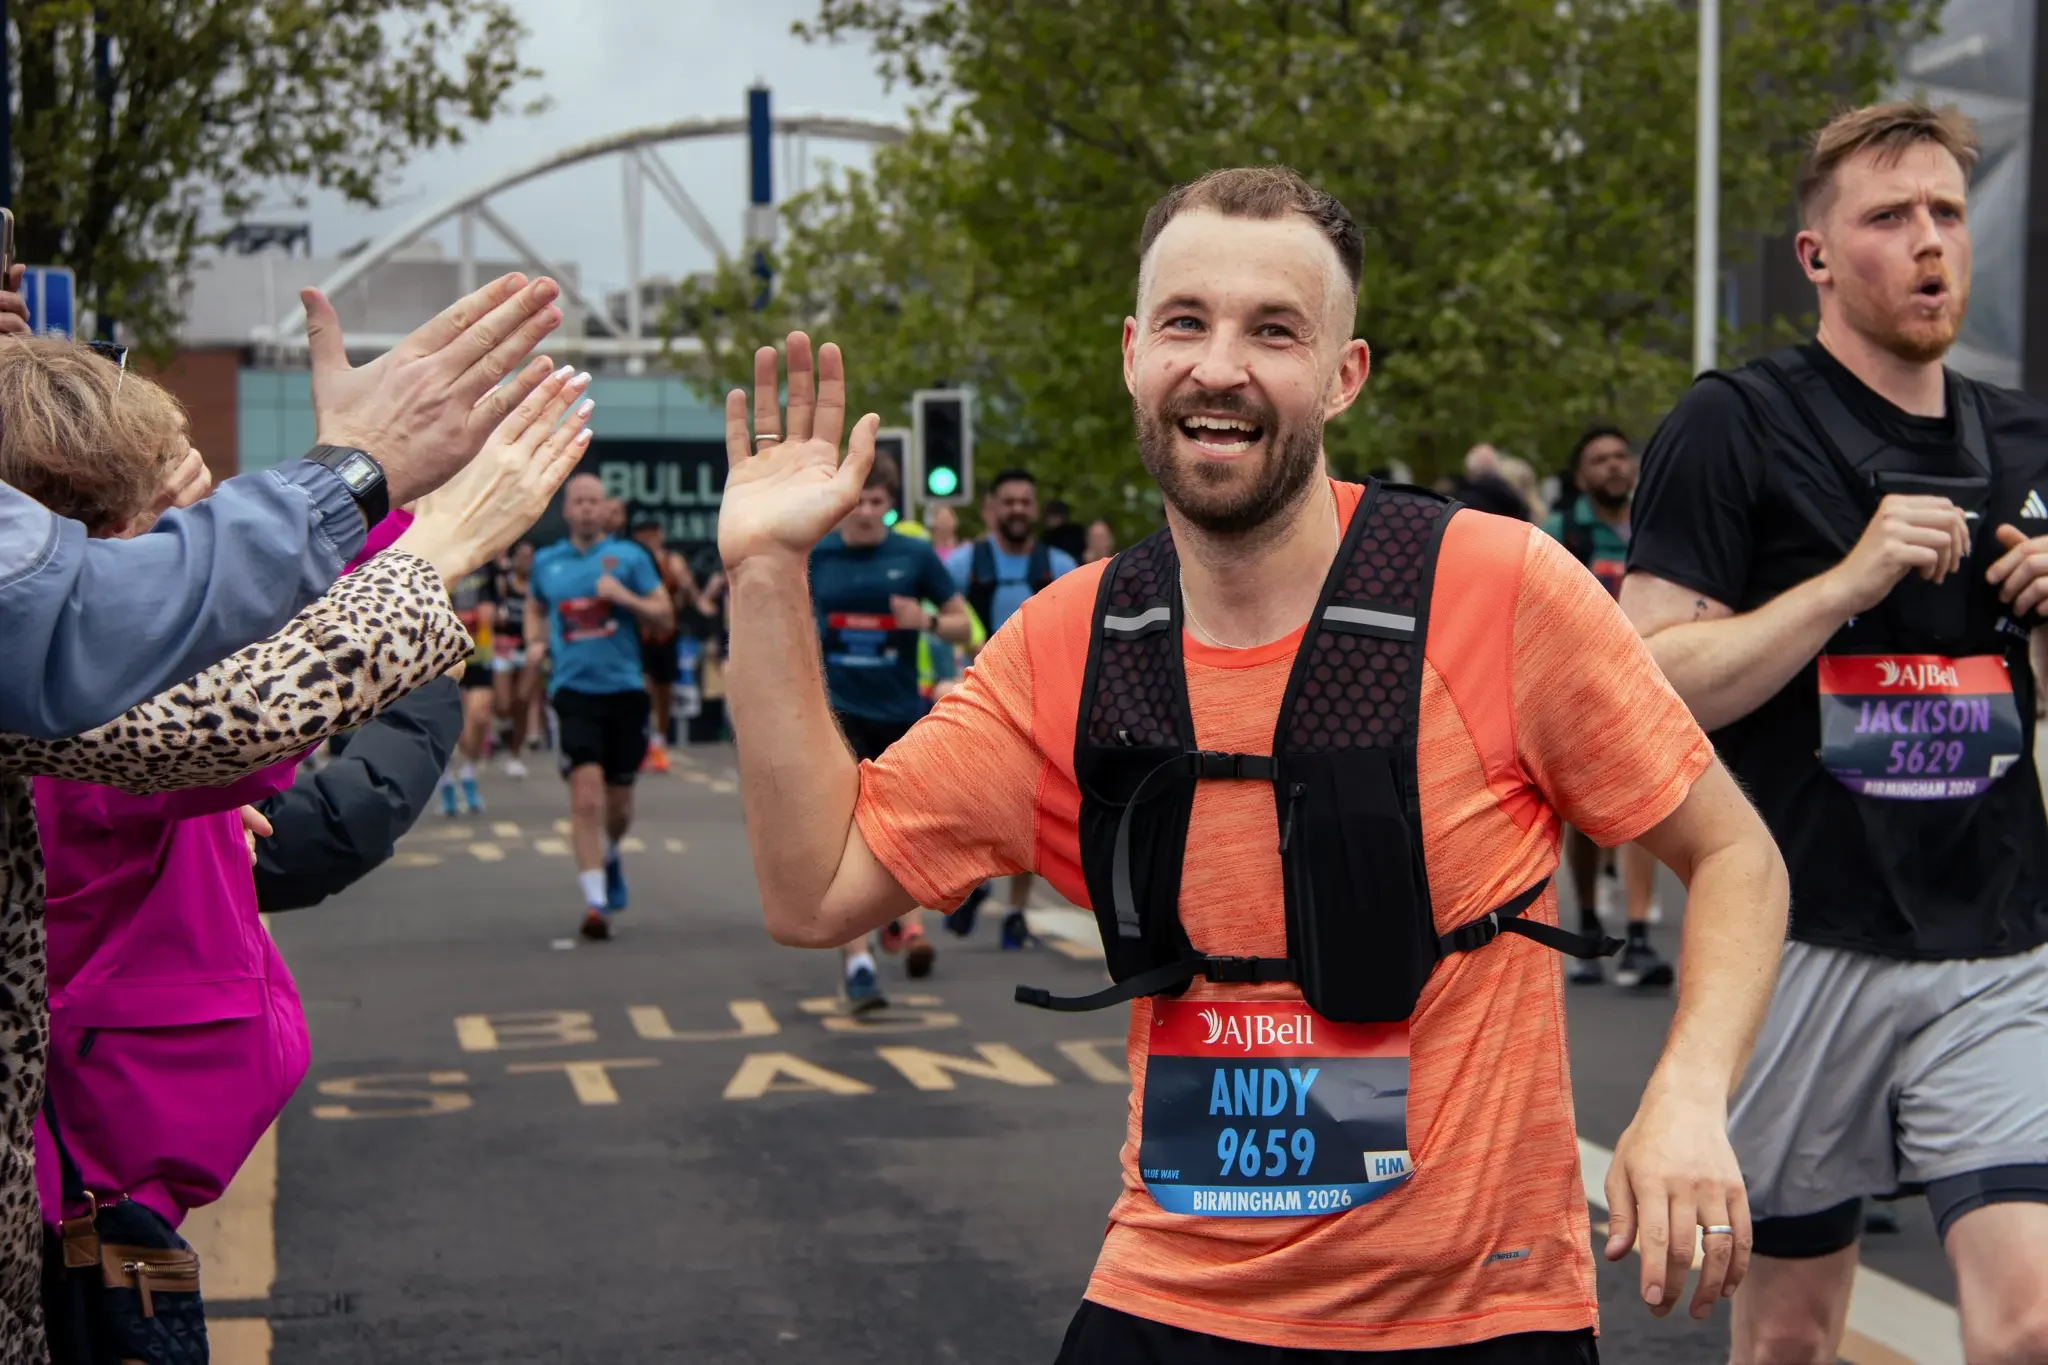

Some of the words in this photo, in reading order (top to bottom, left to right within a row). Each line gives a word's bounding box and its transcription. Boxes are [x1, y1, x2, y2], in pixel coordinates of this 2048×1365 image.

[1855, 698, 1990, 733] JACKSON
[1887, 741, 1964, 774] 5629
[1863, 779, 1945, 796] BIRMINGHAM
[1948, 780, 1976, 796] 2026
[453, 993, 962, 1053] BUS
[1209, 1068, 1320, 1117] ANDY
[1216, 1128, 1316, 1177] 9659
[1375, 1157, 1404, 1176] HM
[1143, 1168, 1159, 1179] BLUE
[1160, 1169, 1181, 1180] WAVE
[1192, 1190, 1302, 1211] BIRMINGHAM
[1307, 1189, 1352, 1210] 2026
